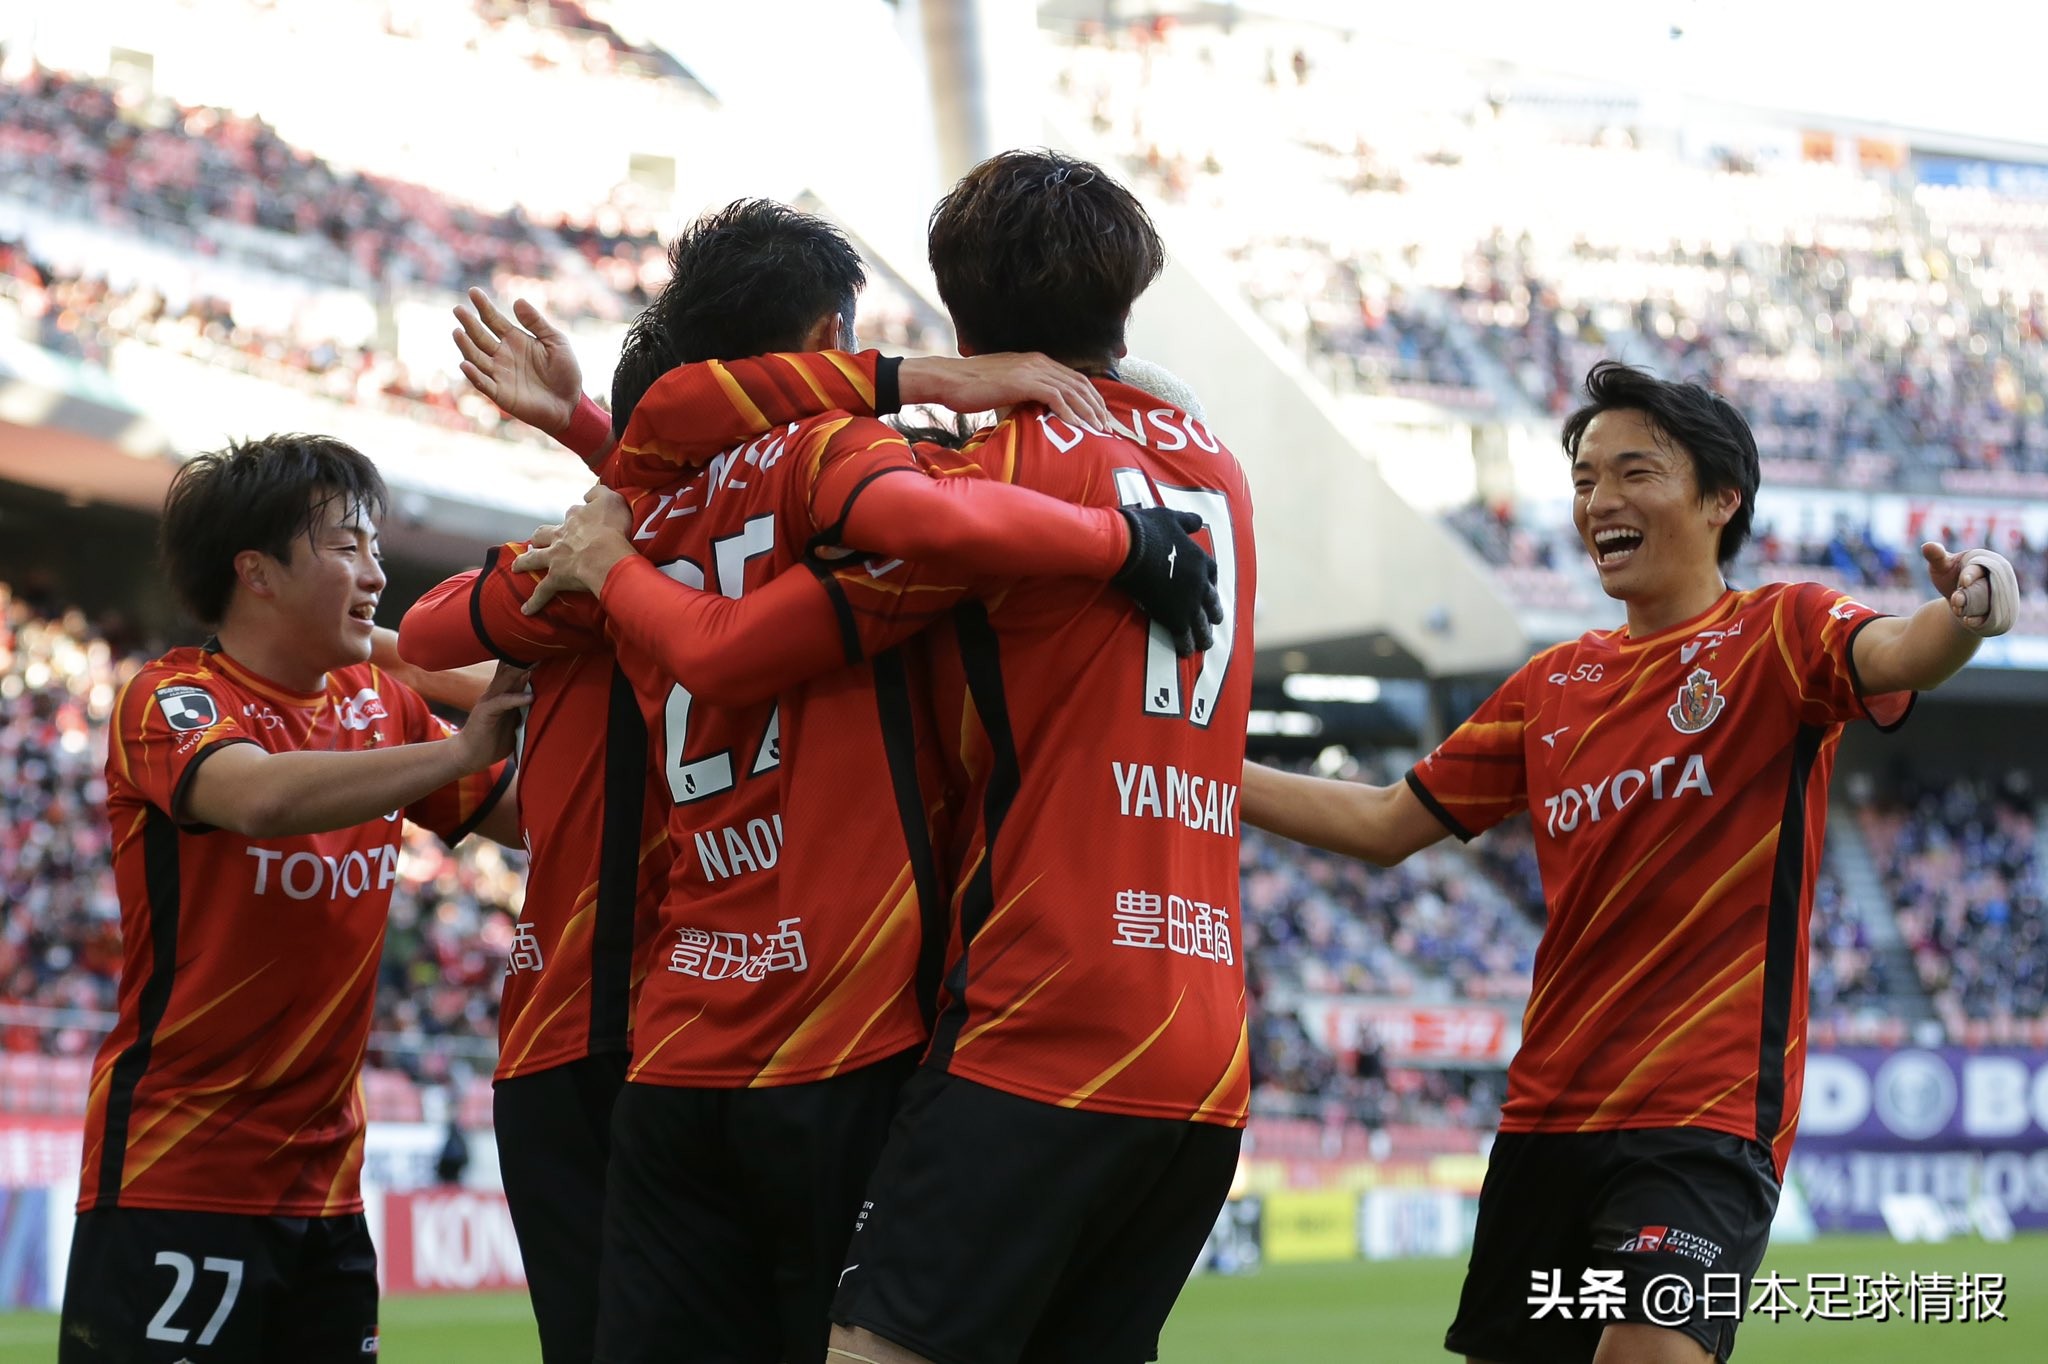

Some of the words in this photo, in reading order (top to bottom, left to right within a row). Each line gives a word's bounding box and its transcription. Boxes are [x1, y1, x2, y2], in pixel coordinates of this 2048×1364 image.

[1036, 408, 1220, 454] DNSO
[1570, 663, 1604, 682] 5G
[1545, 754, 1714, 838] TOYOTA
[246, 843, 399, 900] TOYOTA
[1617, 1236, 1659, 1252] GR
[1666, 1237, 1716, 1260] GAZOO
[1671, 1228, 1722, 1255] TOYOTA
[1664, 1245, 1713, 1268] Racing
[146, 1251, 244, 1346] 27
